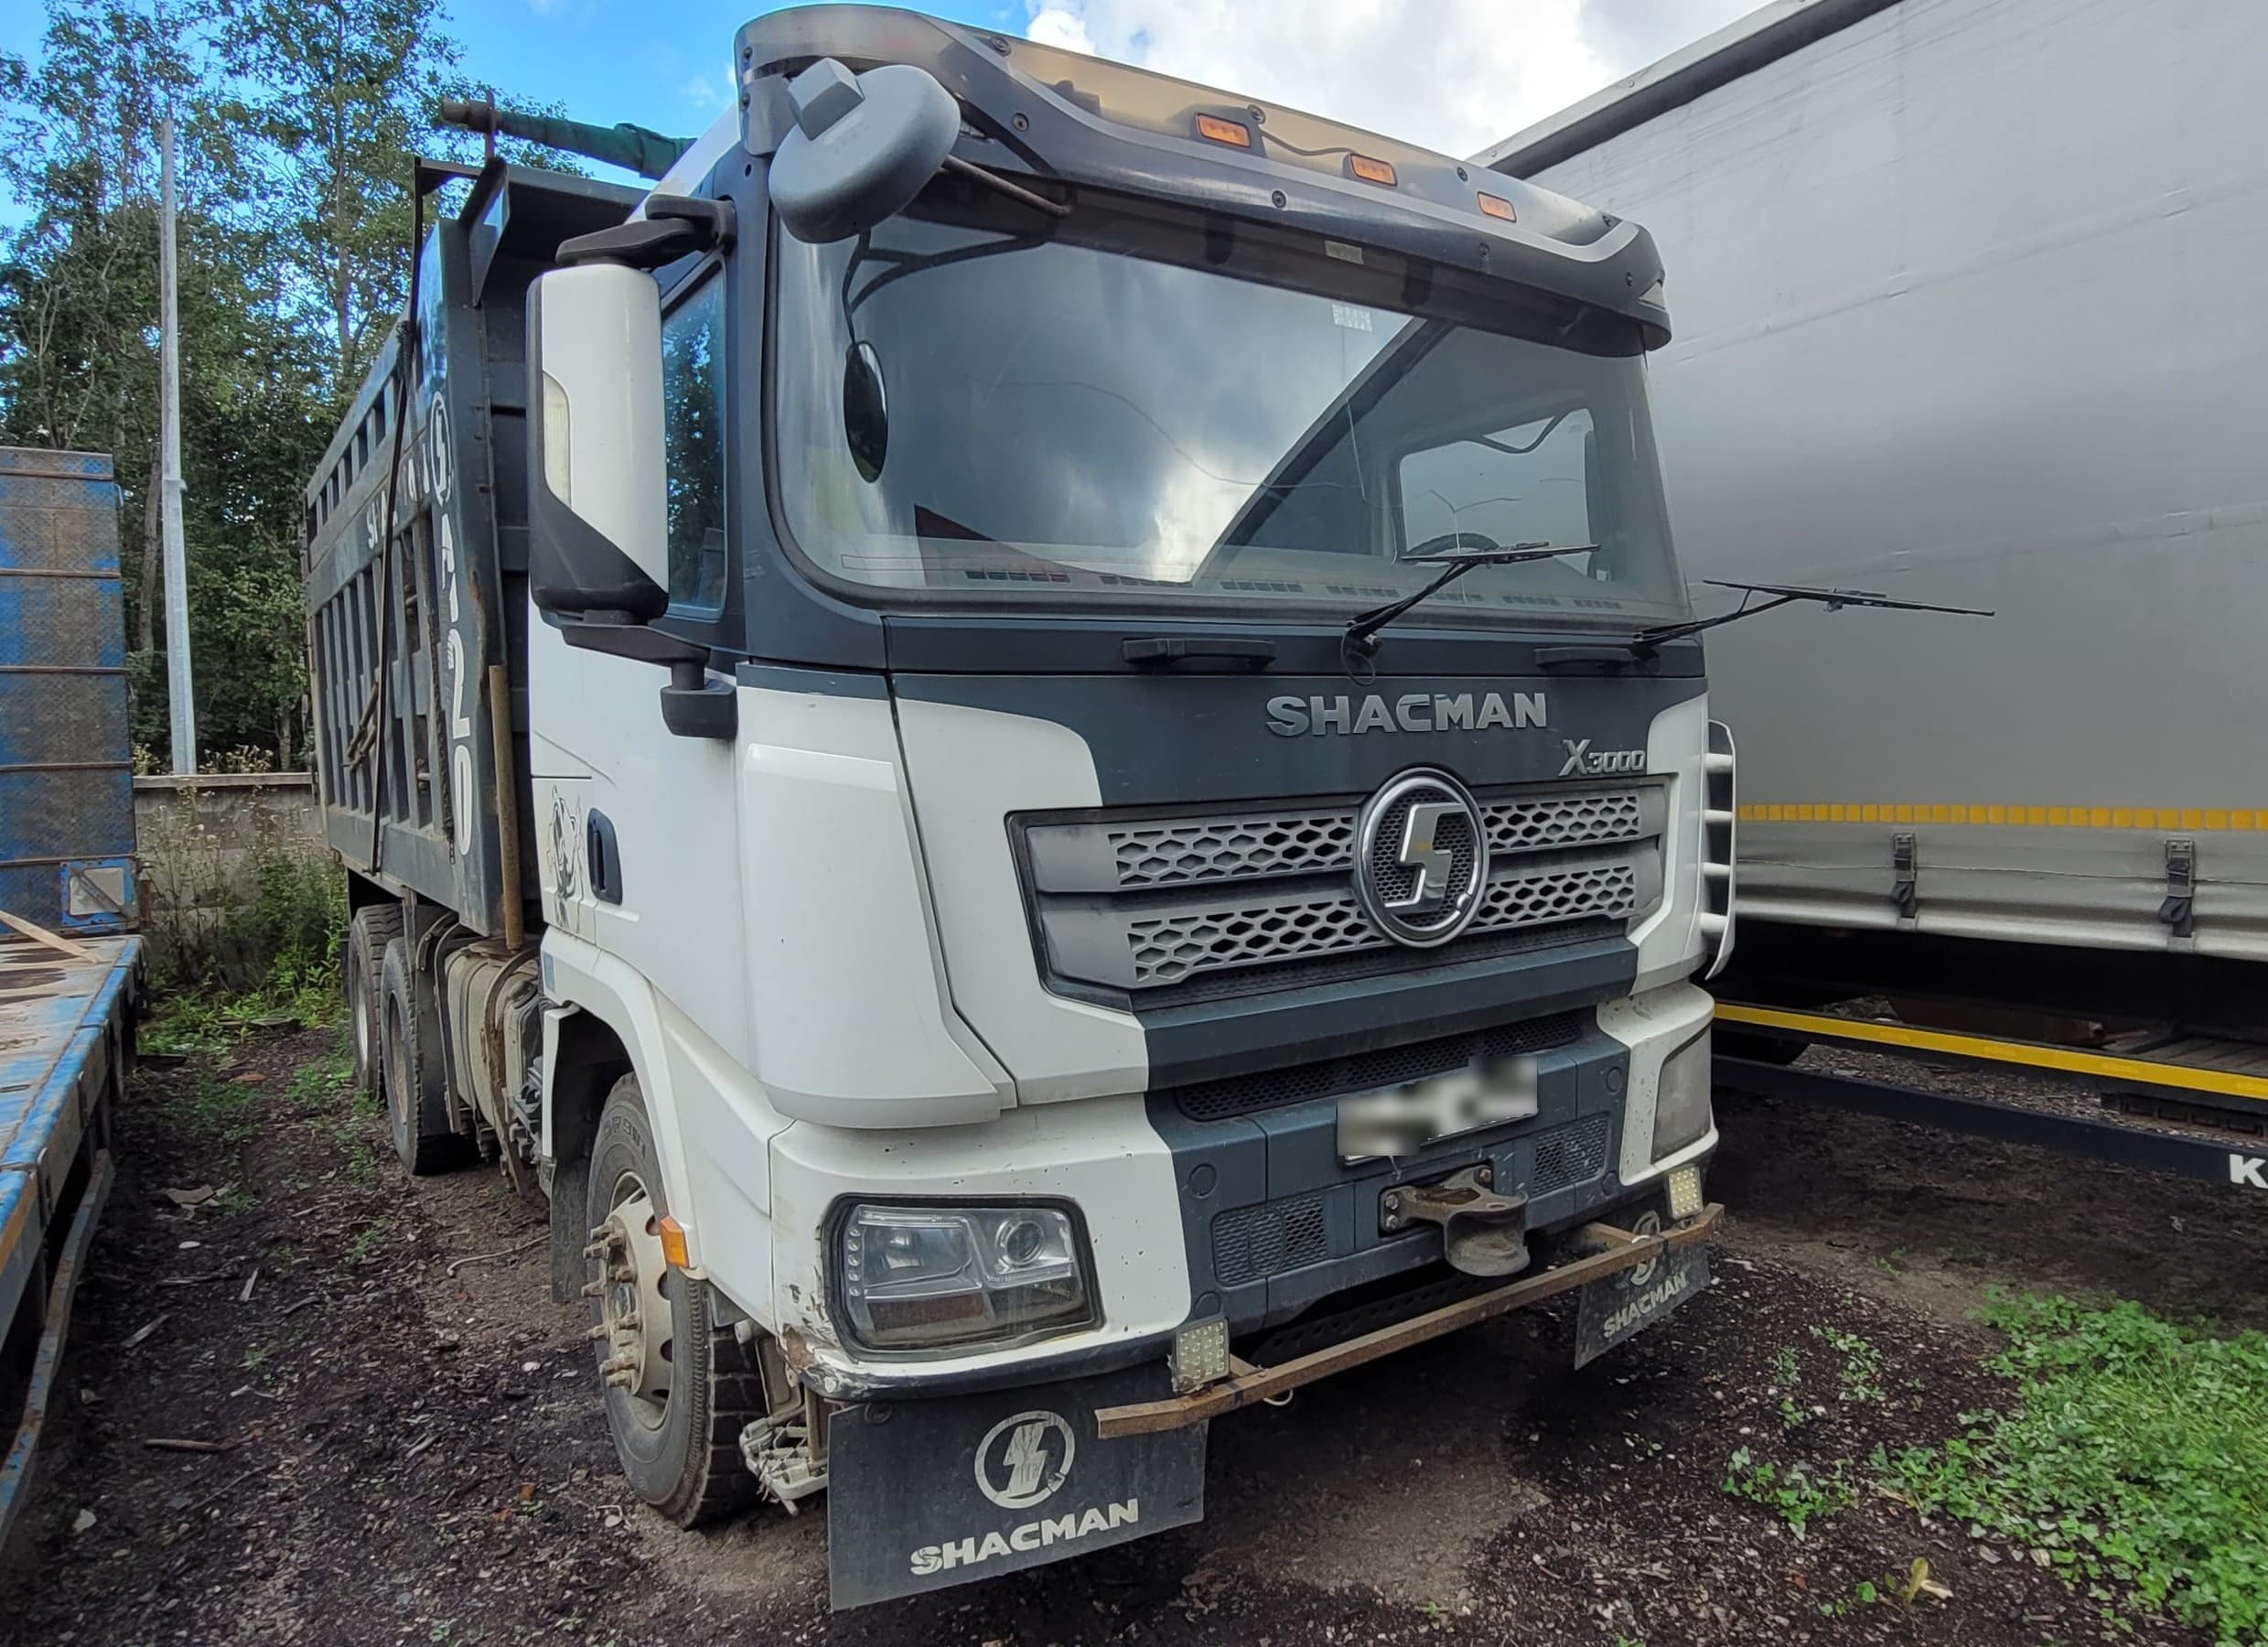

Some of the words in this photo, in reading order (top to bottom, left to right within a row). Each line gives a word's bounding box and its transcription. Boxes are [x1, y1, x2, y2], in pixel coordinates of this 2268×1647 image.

[1265, 693, 1547, 736] SHACMAN
[1558, 738, 1645, 777] X3000
[1603, 1271, 1688, 1339] SHACMAN
[909, 1498, 1139, 1576] SHACMAN
